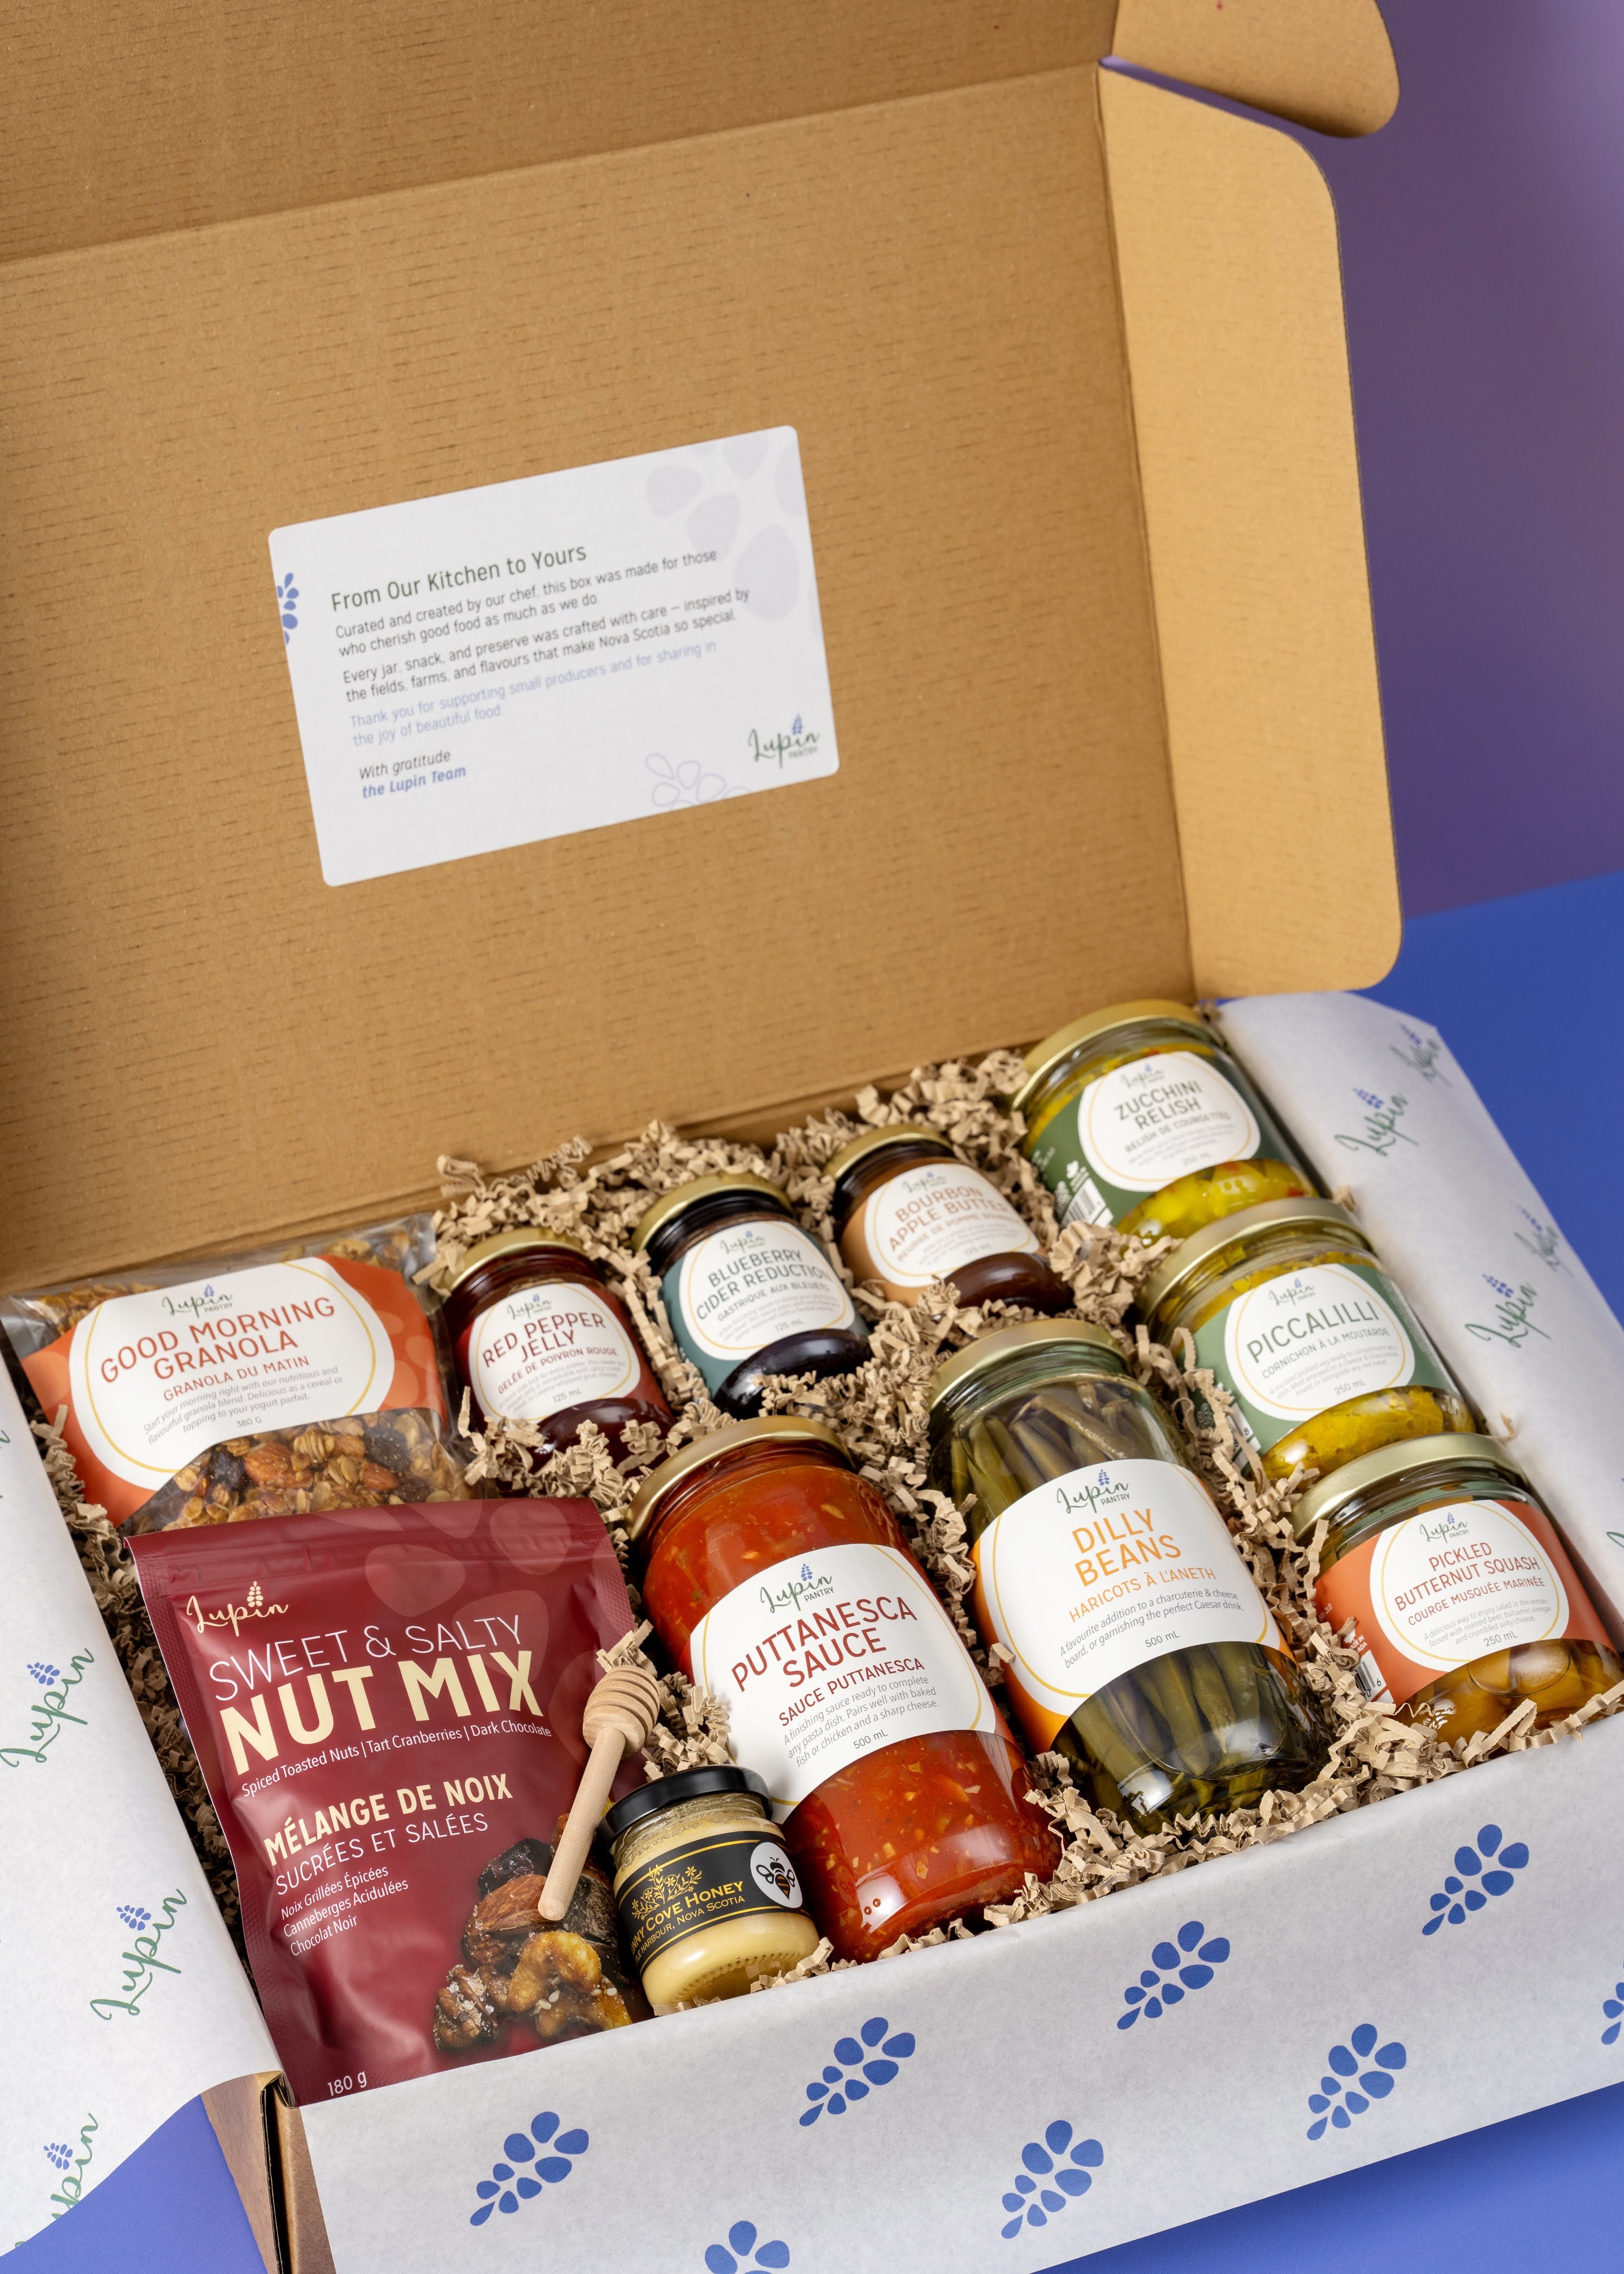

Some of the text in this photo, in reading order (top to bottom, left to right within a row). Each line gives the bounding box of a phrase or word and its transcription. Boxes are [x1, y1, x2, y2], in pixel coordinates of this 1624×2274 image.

[331, 546, 586, 611] From Our Kitchen to Yours
[335, 617, 385, 638] Curated
[389, 611, 412, 628] and
[416, 600, 463, 622] created
[466, 598, 481, 613] by
[485, 594, 505, 607] our
[542, 581, 566, 595] this
[569, 577, 591, 590] box
[595, 570, 621, 584] was
[625, 561, 658, 577] made
[662, 558, 678, 569] for
[682, 550, 716, 566] those
[359, 750, 450, 780] With gratitude
[748, 728, 821, 769] Lupin
[362, 767, 466, 798] the Lupin Team
[1114, 1080, 1202, 1120] ZUCCHINI
[1135, 1097, 1201, 1129] RELISH
[1334, 1092, 1419, 1156] Lupin
[889, 1208, 940, 1251] APPLE
[708, 1249, 802, 1288] BLUEBERRY
[162, 1291, 233, 1319] Lupin
[697, 1281, 739, 1319] CIDER
[1268, 1283, 1314, 1306] Lupin
[1464, 1282, 1551, 1349] Lupin
[101, 1297, 334, 1382] GOOD MORNING
[154, 1330, 298, 1379] GRANOLA
[482, 1312, 606, 1368] RED PEPPER
[521, 1329, 574, 1362] JELLY
[1246, 1301, 1379, 1363] PICCALILLI
[1262, 1344, 1317, 1378] CORNICHON
[1319, 1339, 1326, 1349] À
[1341, 1327, 1390, 1340] MOUTARDE
[163, 1356, 309, 1401] GRANOLA DU MATIN
[525, 1363, 537, 1374] DE
[540, 1348, 584, 1366] POIVRON
[586, 1347, 617, 1356] ROUGE
[552, 1388, 582, 1403] 125 mL
[1334, 1378, 1366, 1395] 250 mL
[237, 1418, 253, 1427] 380
[1056, 1482, 1131, 1513] Lupin PANTRY
[1071, 1508, 1154, 1553] DILLY
[1419, 1519, 1469, 1544] Lupin PANTRY
[1074, 1534, 1181, 1586] BEANS
[1429, 1542, 1491, 1571] PICKLED
[759, 1576, 835, 1614] Lupin PANTRY
[1069, 1578, 1141, 1622] HARICOTS
[1143, 1571, 1157, 1586] À
[1394, 1556, 1540, 1611] BUTTERNUT SQUASH
[1408, 1576, 1545, 1625] COURGE MUSQUÉE MARINÉE
[185, 1595, 289, 1637] Lupin
[1060, 1646, 1066, 1657] A
[1065, 1624, 1099, 1651] favourite
[1101, 1605, 1136, 1628] addition
[1137, 1602, 1147, 1610] to
[1156, 1589, 1203, 1604] charcuterie
[1204, 1588, 1212, 1597] &
[1212, 1589, 1238, 1599] cheese
[1064, 1644, 1088, 1668] board,
[1089, 1639, 1097, 1649] or
[1098, 1616, 1144, 1646] garnishing
[1145, 1610, 1161, 1620] the
[1163, 1602, 1193, 1618] perfect
[1194, 1600, 1221, 1609] Caesar
[1144, 1630, 1180, 1648] 500 mL
[1483, 1630, 1518, 1646] 250 mL
[209, 1615, 520, 1701] SWEET & SALTY
[731, 1596, 918, 1692] PUTTANESCA
[782, 1627, 887, 1687] SAUCE
[0, 1647, 95, 1768] Lupin
[219, 1650, 543, 1775] NUT MIX
[778, 1658, 925, 1726] SAUCE PUTTANESCA
[241, 1767, 280, 1797] Spiced
[280, 1750, 327, 1778] Toasted
[329, 1746, 359, 1762] Nuts
[365, 1739, 391, 1753] Tart
[391, 1728, 462, 1748] Cranberries
[470, 1721, 500, 1736] Dark
[501, 1719, 551, 1736] Chocolate
[853, 1729, 888, 1749] 500 mL
[264, 1773, 512, 1866] MÉLANGE DE NOIX
[276, 1813, 488, 1895] SUCRÉES ET SALÉES
[281, 1866, 388, 1920] Noix Grillées Épicées
[283, 1879, 409, 1938] Canneberges Acidulées
[646, 1901, 683, 1931] COVE
[684, 1881, 744, 1909] HONEY
[290, 1914, 357, 1956] Chocolat Noir
[641, 1896, 745, 1953] HARBOUR, NOVA SCOTIA
[89, 1887, 187, 2021] Lupin
[327, 2071, 367, 2096] 180 g
